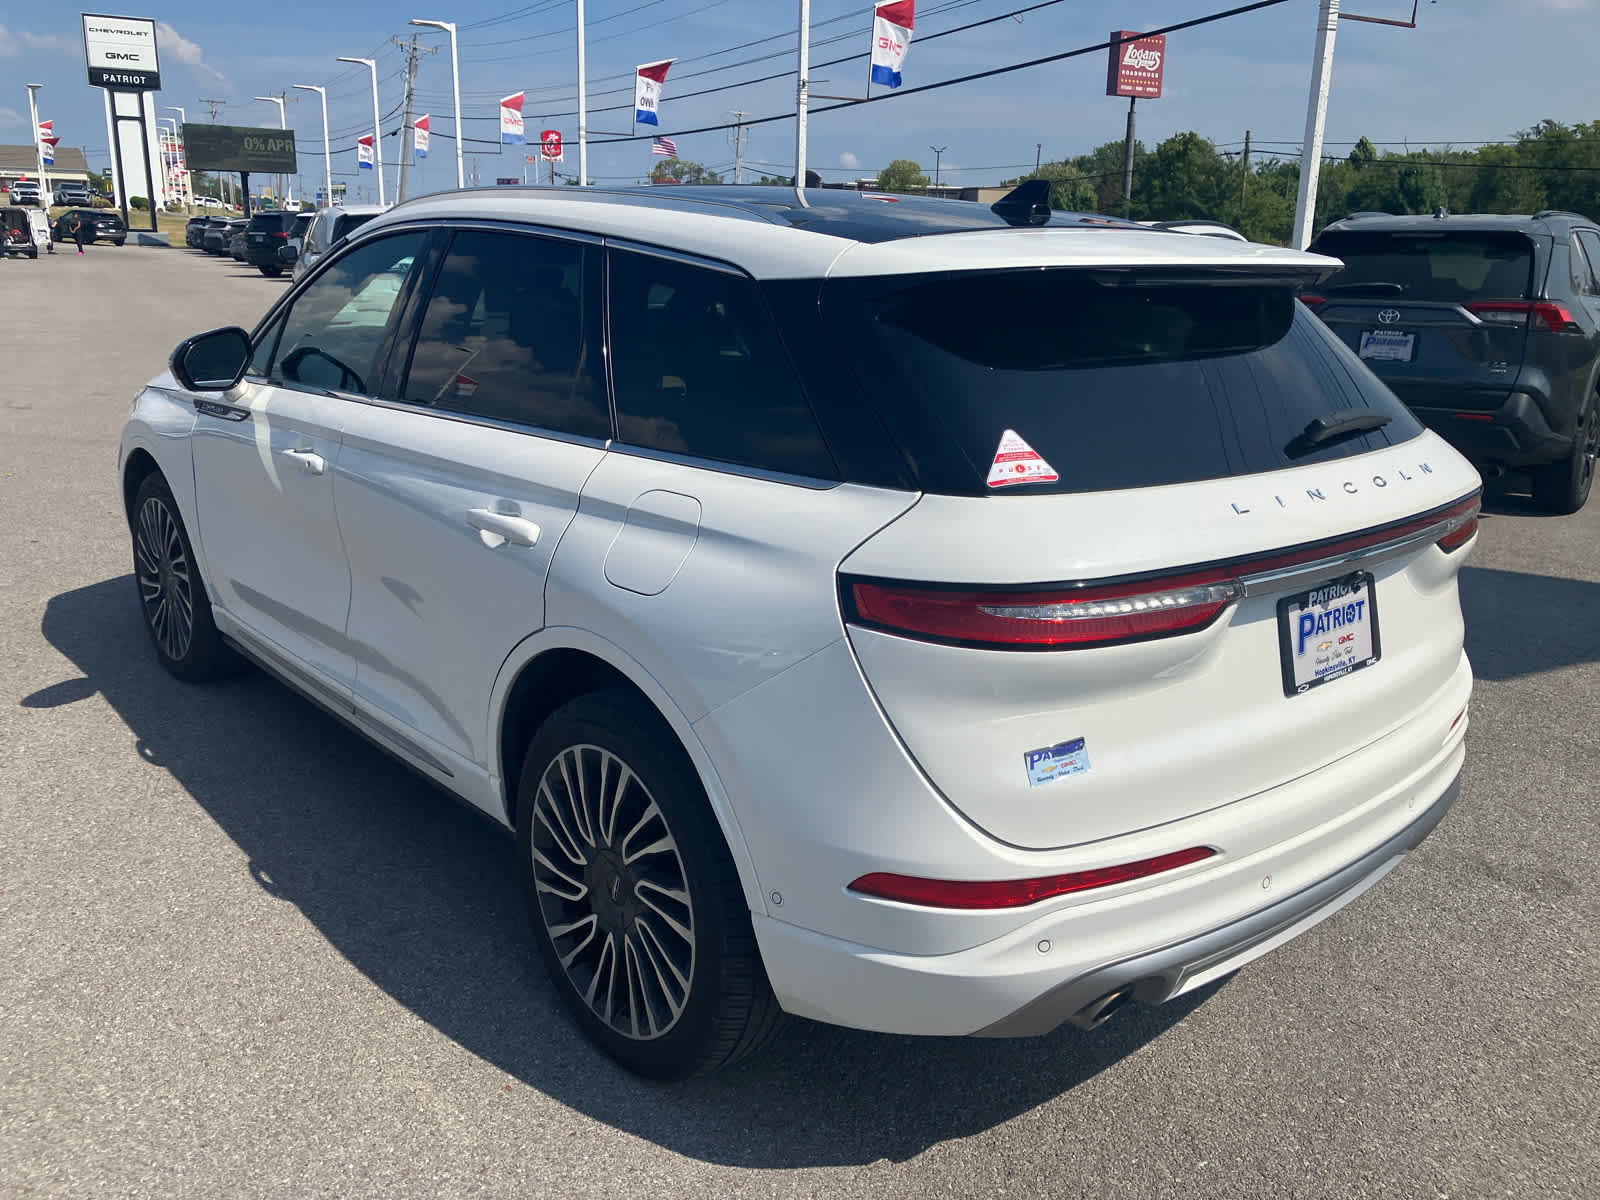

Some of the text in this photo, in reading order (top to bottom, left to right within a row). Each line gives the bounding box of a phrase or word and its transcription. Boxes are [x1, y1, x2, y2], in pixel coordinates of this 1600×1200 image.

[88, 27, 149, 37] CHEVROLET
[105, 52, 140, 61] GMC
[103, 73, 146, 85] PATRIOT
[1121, 69, 1159, 79] ROADHOUSE
[267, 138, 294, 153] APR
[1231, 462, 1433, 515] LINCOLN
[1297, 600, 1365, 656] PATRIOT
[1338, 633, 1355, 645] GMC
